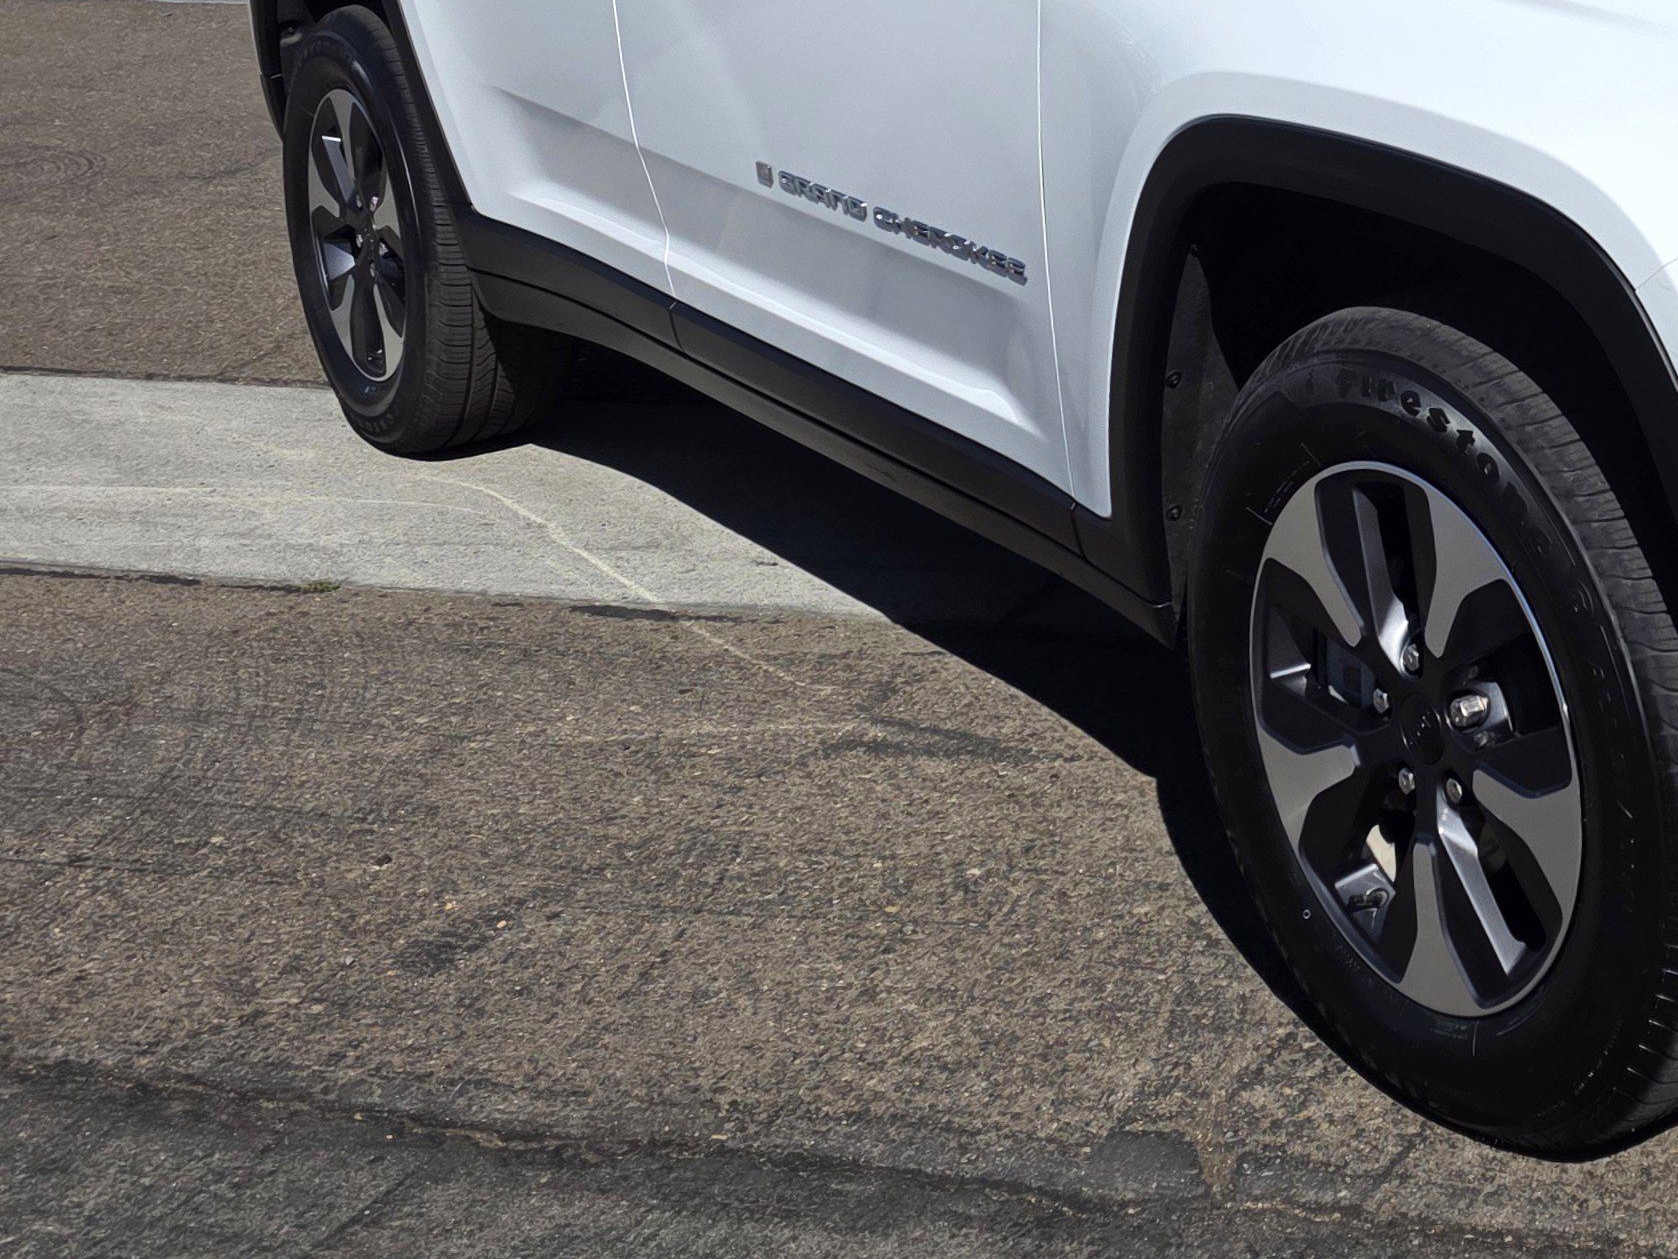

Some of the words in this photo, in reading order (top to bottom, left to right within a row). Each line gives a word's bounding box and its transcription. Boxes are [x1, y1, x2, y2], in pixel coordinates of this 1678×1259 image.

[778, 170, 868, 223] GRAND
[872, 206, 1028, 287] CHEROKEE
[1335, 367, 1556, 558] Firestone
